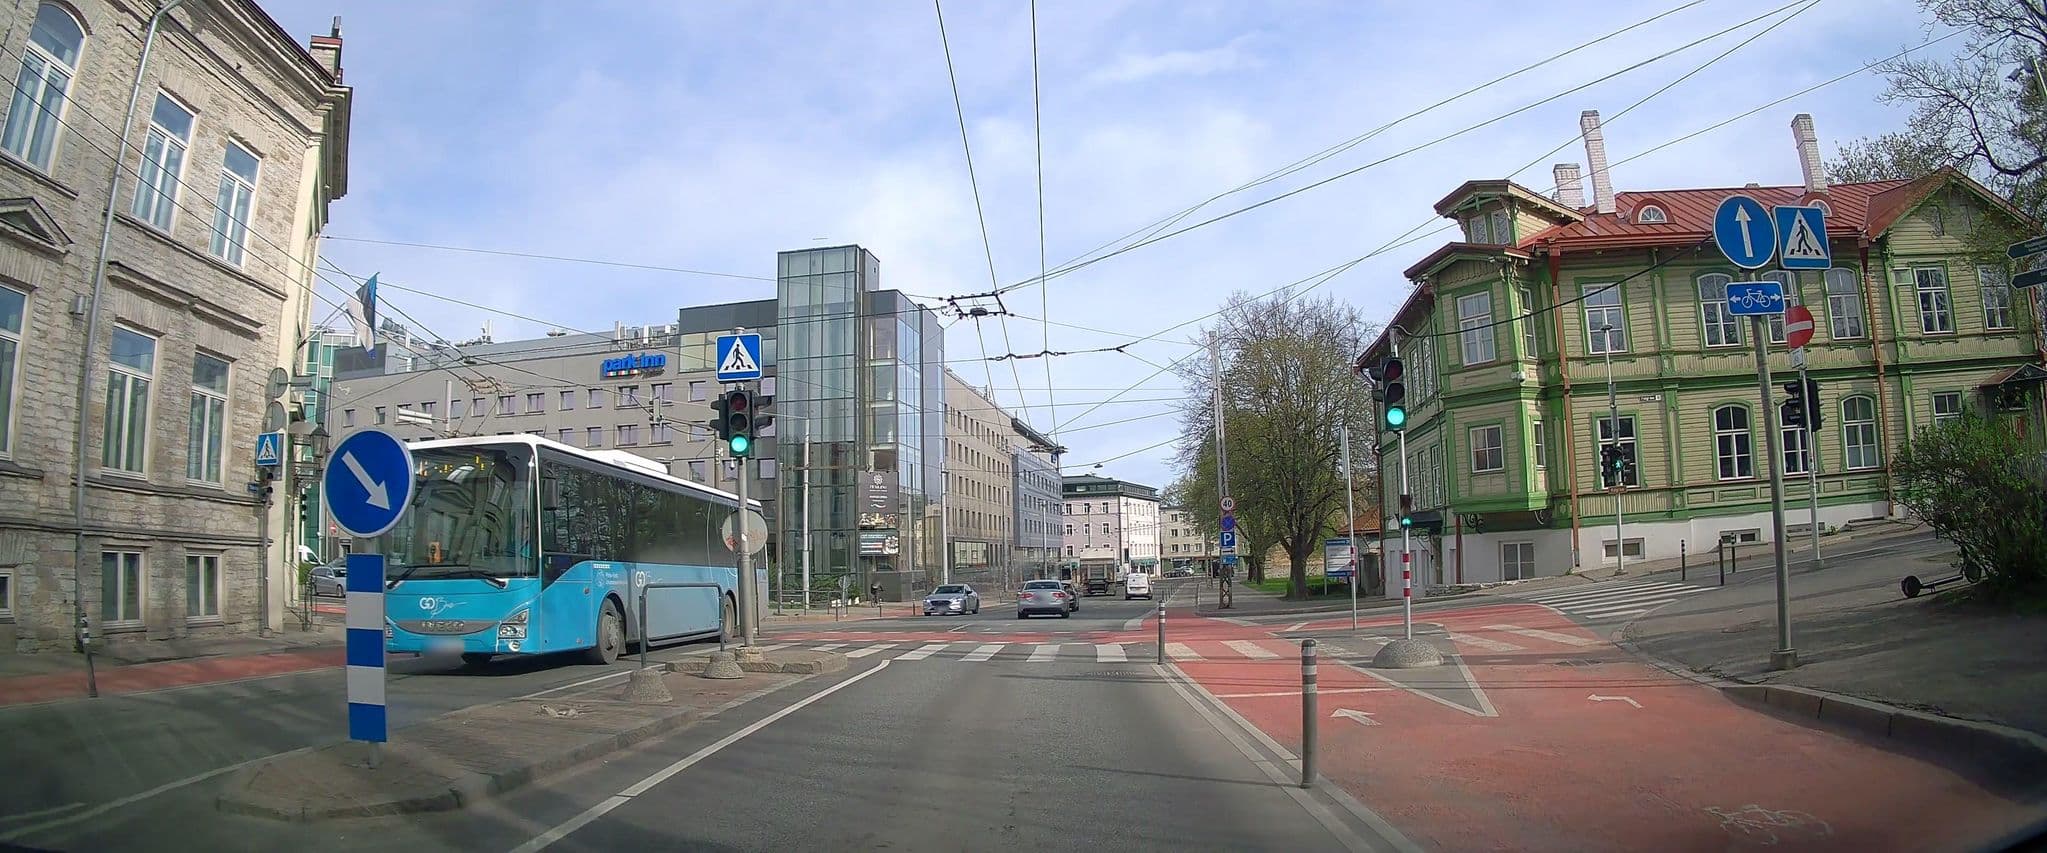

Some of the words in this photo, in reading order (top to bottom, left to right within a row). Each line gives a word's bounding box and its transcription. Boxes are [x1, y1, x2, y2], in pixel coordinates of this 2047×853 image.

[603, 353, 637, 377] park
[640, 351, 666, 368] inn
[1223, 499, 1232, 508] 40
[1223, 532, 1232, 546] P
[421, 620, 465, 632] IVECO
